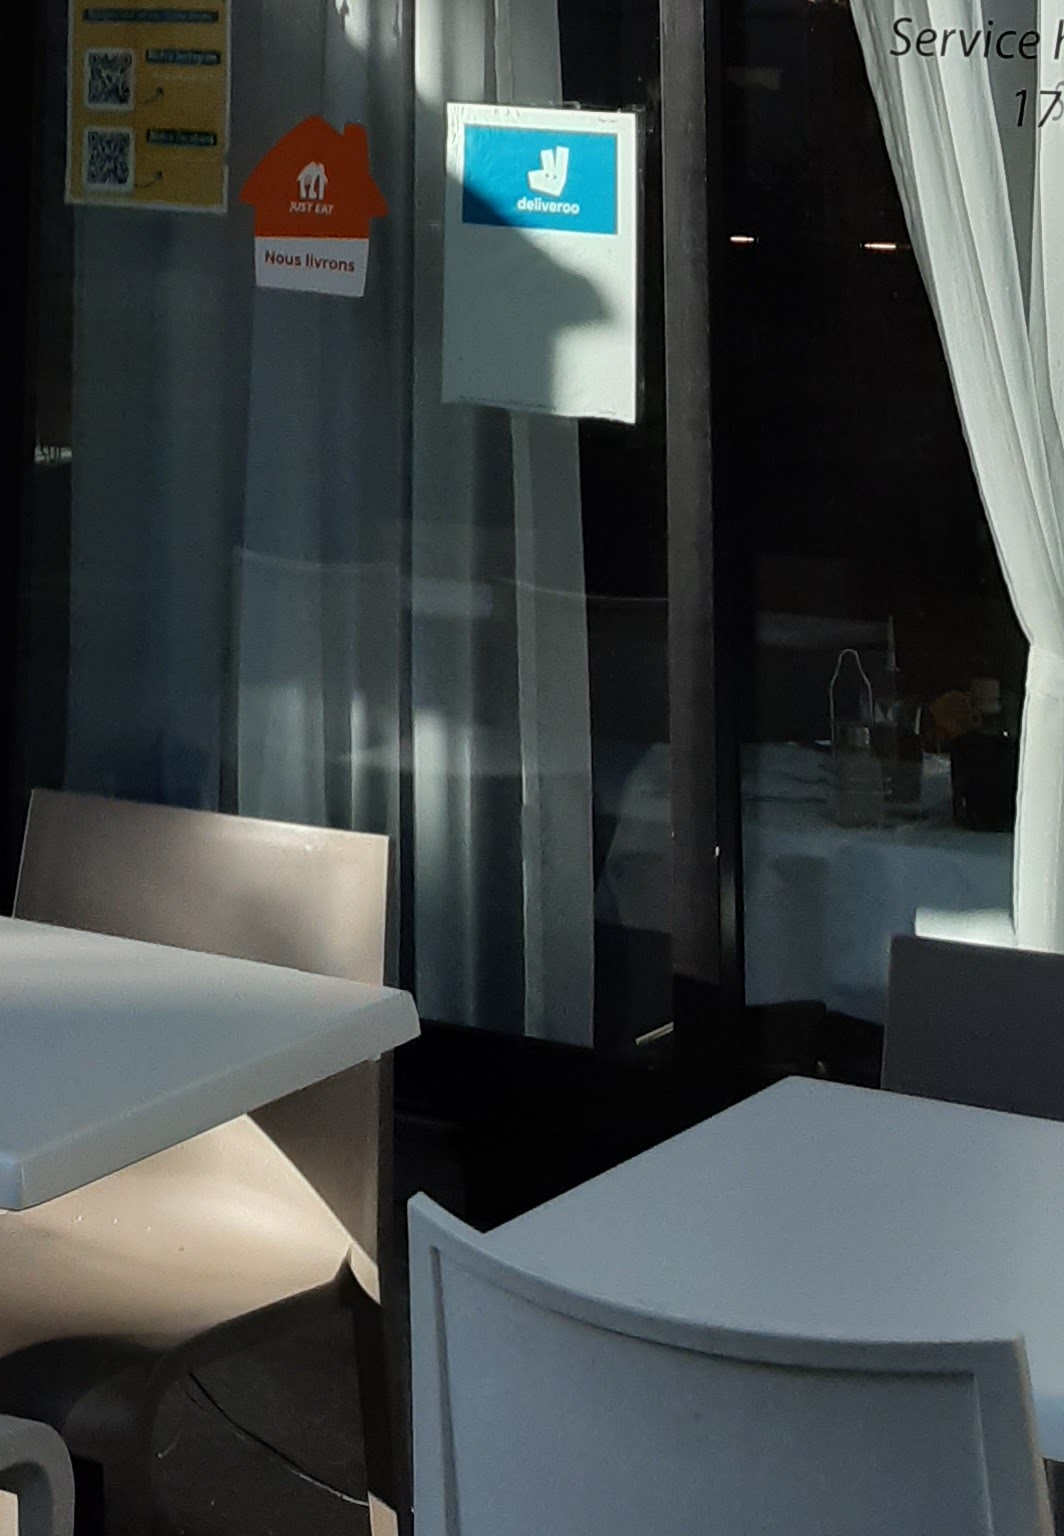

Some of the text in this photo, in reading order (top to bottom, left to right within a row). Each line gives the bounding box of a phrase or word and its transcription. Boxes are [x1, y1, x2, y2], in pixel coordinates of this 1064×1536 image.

[889, 16, 1041, 60] Service
[1015, 89, 1063, 128] 17
[288, 200, 335, 216] JUST EAT
[517, 195, 581, 216] deliveroo
[264, 249, 356, 273] Nous livrons
